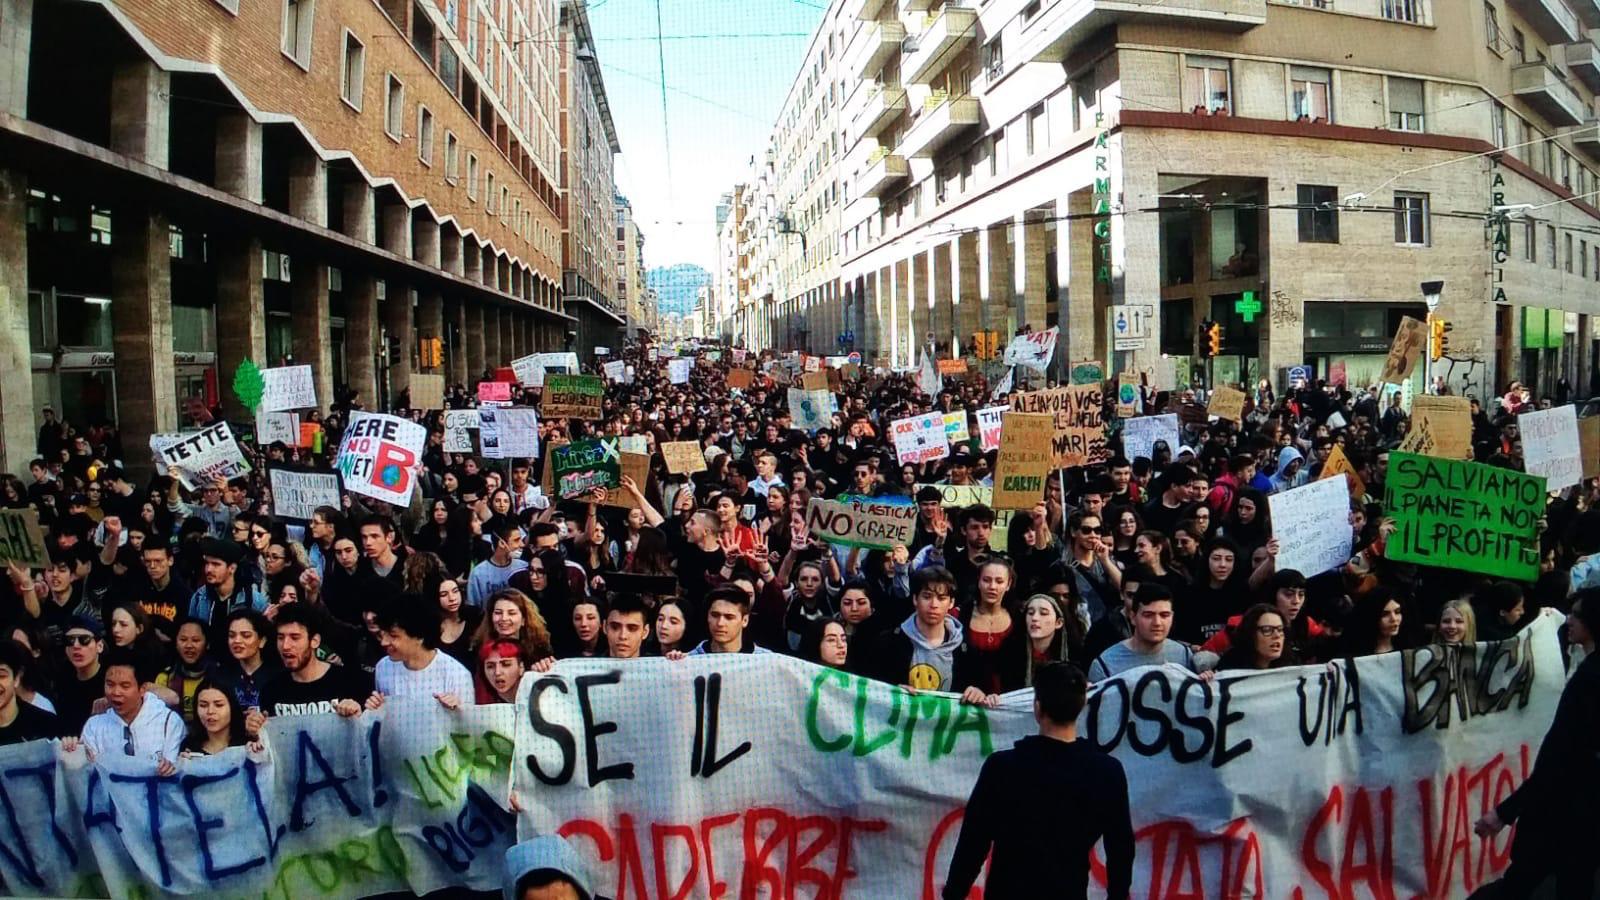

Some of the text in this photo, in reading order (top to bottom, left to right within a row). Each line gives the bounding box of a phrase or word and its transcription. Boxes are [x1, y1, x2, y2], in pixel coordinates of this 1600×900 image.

[1095, 112, 1111, 283] FARMACIA
[981, 412, 1002, 423] TH
[1075, 390, 1102, 410] VOCE
[163, 423, 229, 463] TETTE
[1052, 434, 1087, 456] MARI
[371, 441, 415, 494] B
[1397, 459, 1540, 505] SALVIAMO
[809, 505, 852, 536] NO
[853, 500, 917, 518] PLASTICA?
[1385, 488, 1543, 529] IL PIANETA NON
[856, 521, 908, 541] GRAZIE
[1403, 519, 1540, 566] IL PROFITTO
[526, 670, 635, 788] SE
[690, 672, 752, 778] IL
[805, 667, 995, 761] CLIMA
[1085, 670, 1253, 769] OSSE
[1401, 627, 1535, 735] BANCA
